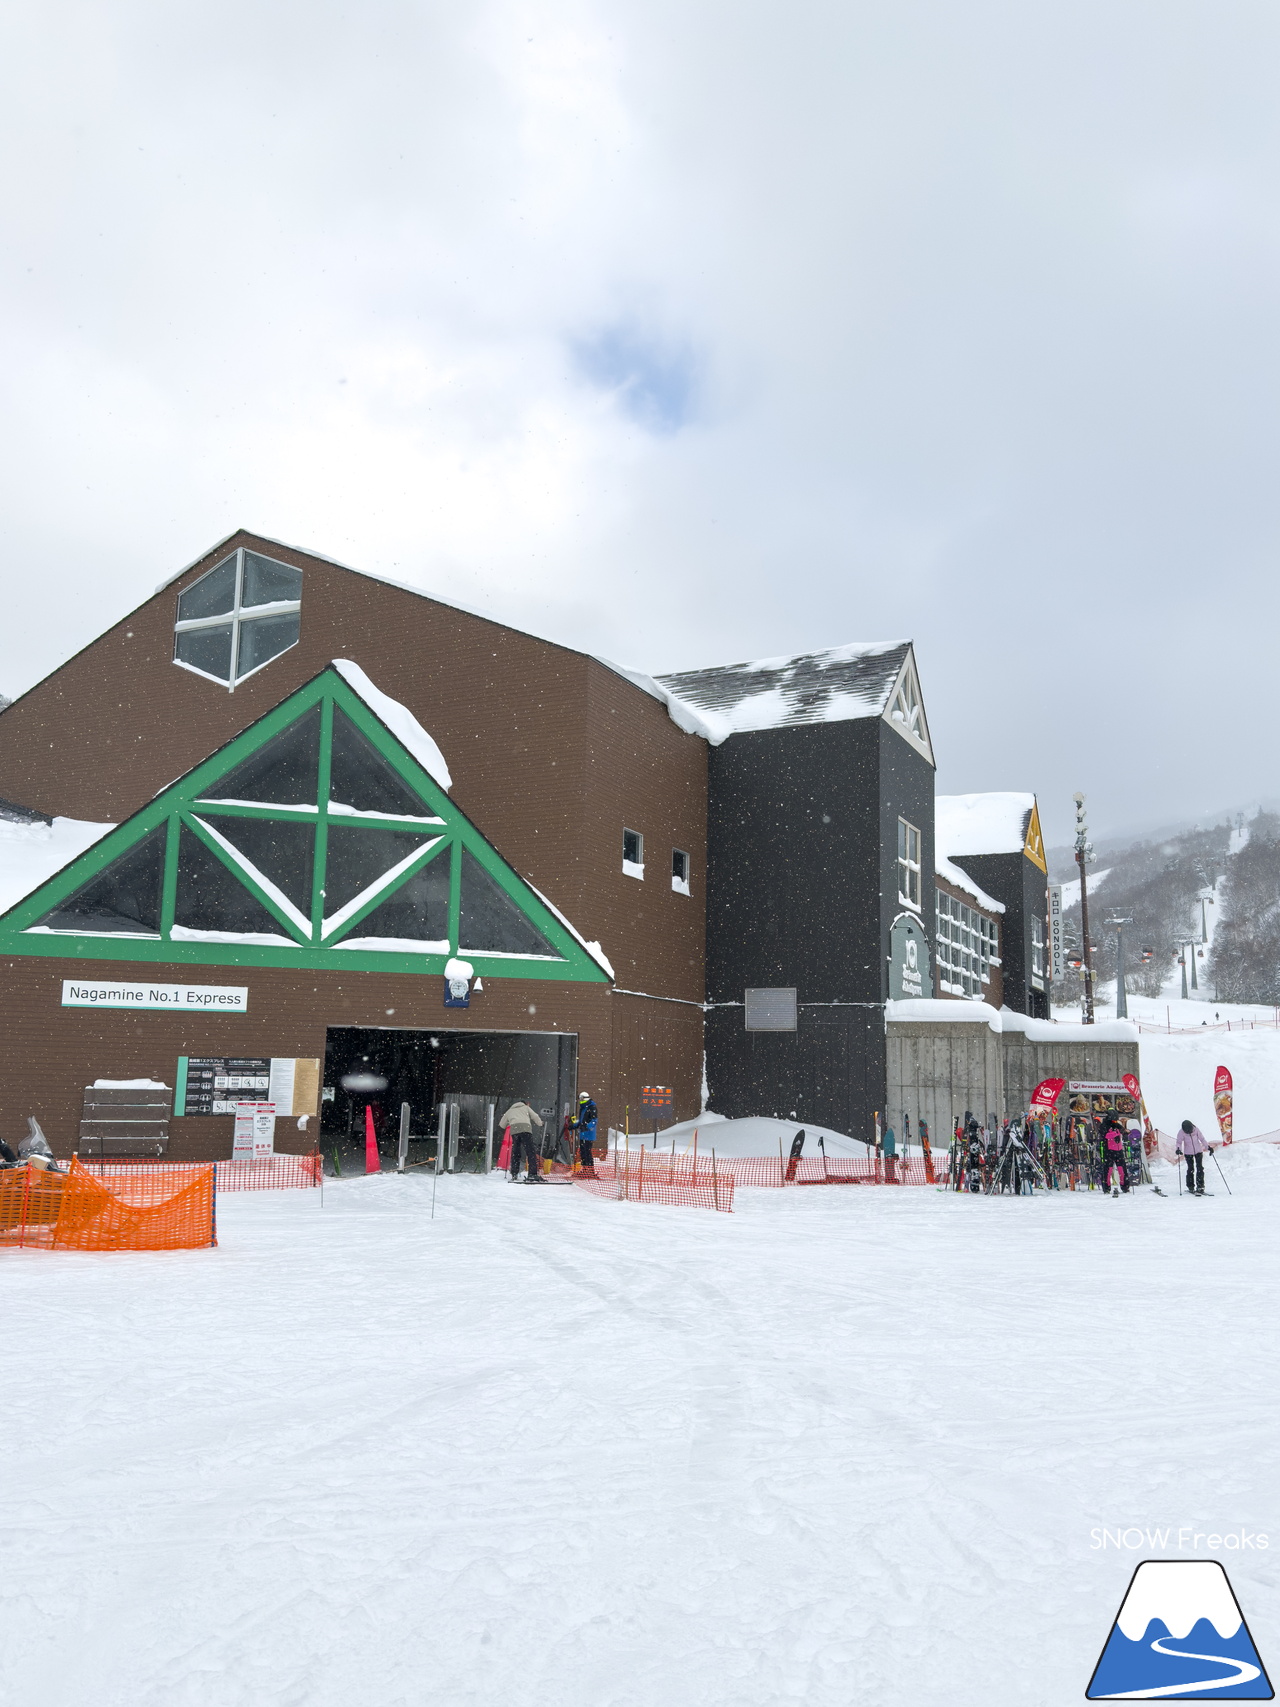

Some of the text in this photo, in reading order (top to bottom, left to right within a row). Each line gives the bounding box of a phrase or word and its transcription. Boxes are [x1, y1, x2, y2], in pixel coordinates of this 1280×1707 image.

[1053, 920, 1061, 975] GONDOLA
[69, 986, 241, 1006] Nagamine No.1 Express
